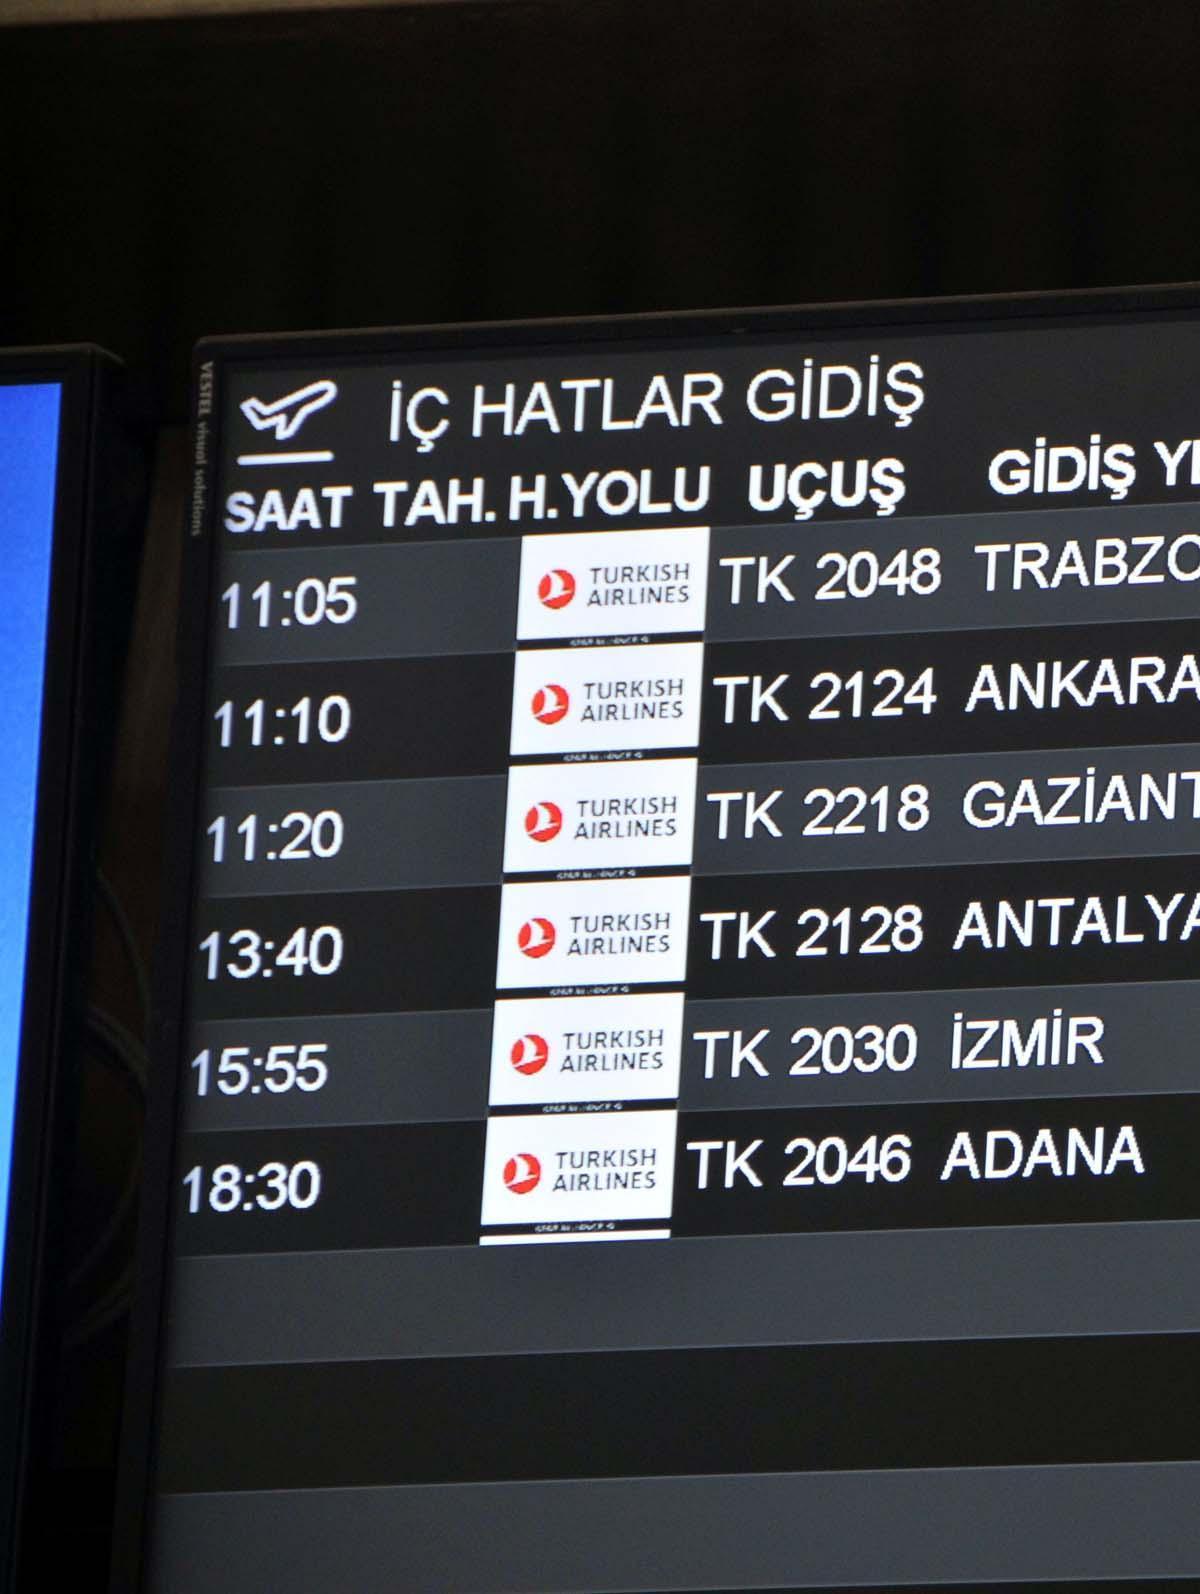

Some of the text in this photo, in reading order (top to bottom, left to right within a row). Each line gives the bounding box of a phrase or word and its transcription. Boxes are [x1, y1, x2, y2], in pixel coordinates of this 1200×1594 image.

[389, 354, 925, 453] İÇ HATLAR GİDİŞ
[748, 457, 906, 521] UÇUŞ
[988, 433, 1137, 501] GİDİŞ
[226, 485, 353, 533] SAAT
[373, 477, 496, 527] TAH.
[587, 584, 689, 607] AIRLINES
[590, 563, 689, 584] TURKISH
[719, 547, 942, 605] TK 2048
[222, 576, 357, 629] 11:05
[581, 700, 683, 722] AIRLINES
[584, 678, 683, 700] TURKISH
[712, 667, 938, 724] TK 2124
[215, 695, 351, 747] 11:10
[574, 818, 677, 839] AIRLINES
[577, 796, 677, 817] TURKISH
[706, 783, 930, 840] TK 2218
[208, 810, 344, 862] 11:20
[567, 934, 670, 956] AIRLINES
[570, 912, 670, 933] TURKISH
[699, 904, 924, 960] TK 2128
[200, 925, 343, 980] 13:40
[560, 1051, 663, 1073] AIRLINES
[563, 1029, 663, 1050] TURKISH
[692, 1023, 918, 1079] TK 2030
[951, 1008, 1105, 1070] İZMİR
[192, 1043, 328, 1096] 15:55
[556, 1148, 656, 1169] TURKISH
[686, 1134, 912, 1189] TK 2046
[940, 1125, 1145, 1181] ADANA
[184, 1160, 321, 1213] 18:30
[552, 1170, 656, 1191] AIRLINES
